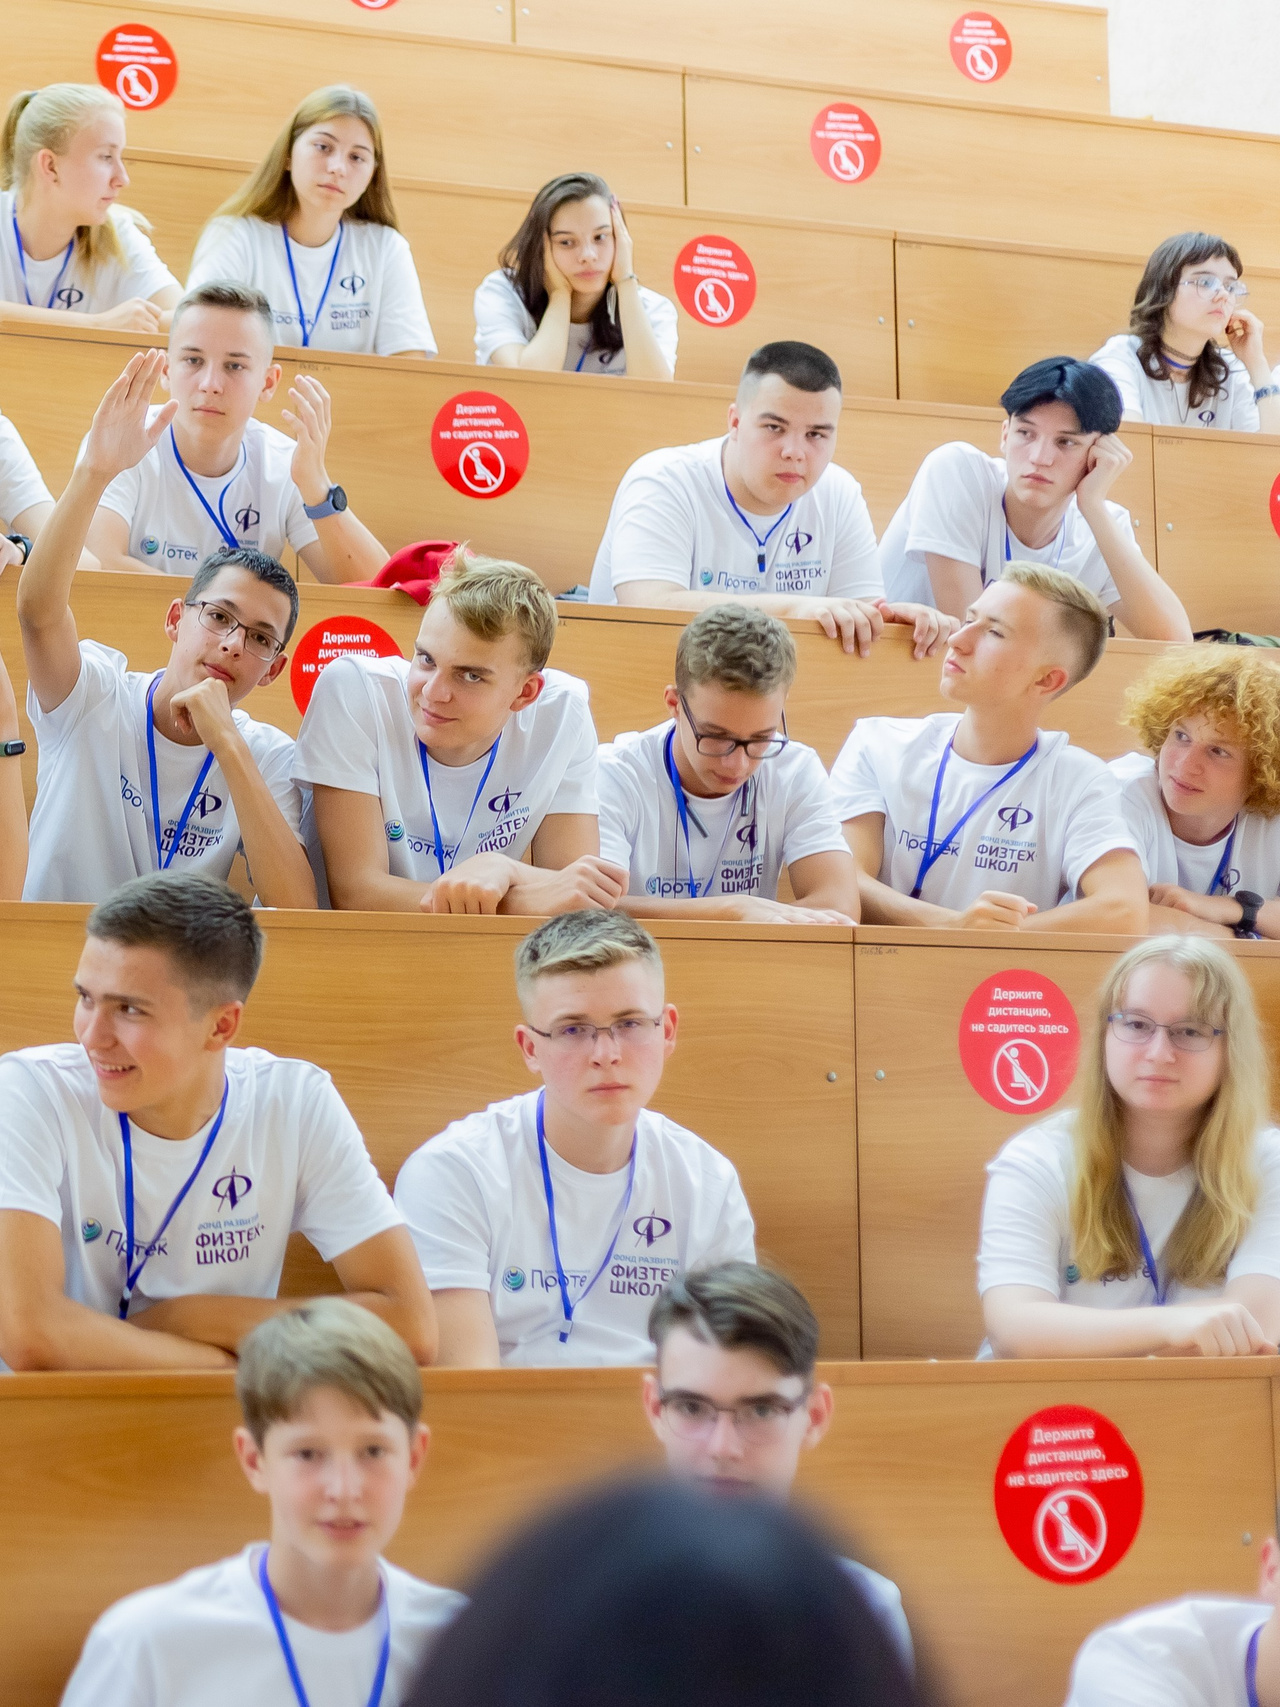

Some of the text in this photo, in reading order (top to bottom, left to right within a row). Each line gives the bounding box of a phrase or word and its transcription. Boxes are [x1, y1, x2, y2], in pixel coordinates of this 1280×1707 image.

[775, 580, 811, 592] ШКОЛ
[322, 632, 371, 644] Держите
[302, 664, 315, 673] не
[974, 856, 1018, 873] ШКОЛ
[993, 987, 1043, 1001] Держите
[988, 1007, 1050, 1018] дистанцию,
[972, 1023, 1069, 1035] не садитесь здесь
[196, 1245, 250, 1265] ШКОЛ
[613, 1253, 637, 1263] ФОНД
[1033, 1427, 1095, 1444] Держите
[1028, 1448, 1106, 1466] дистанцию,
[1008, 1467, 1129, 1487] не садитесь здесь
